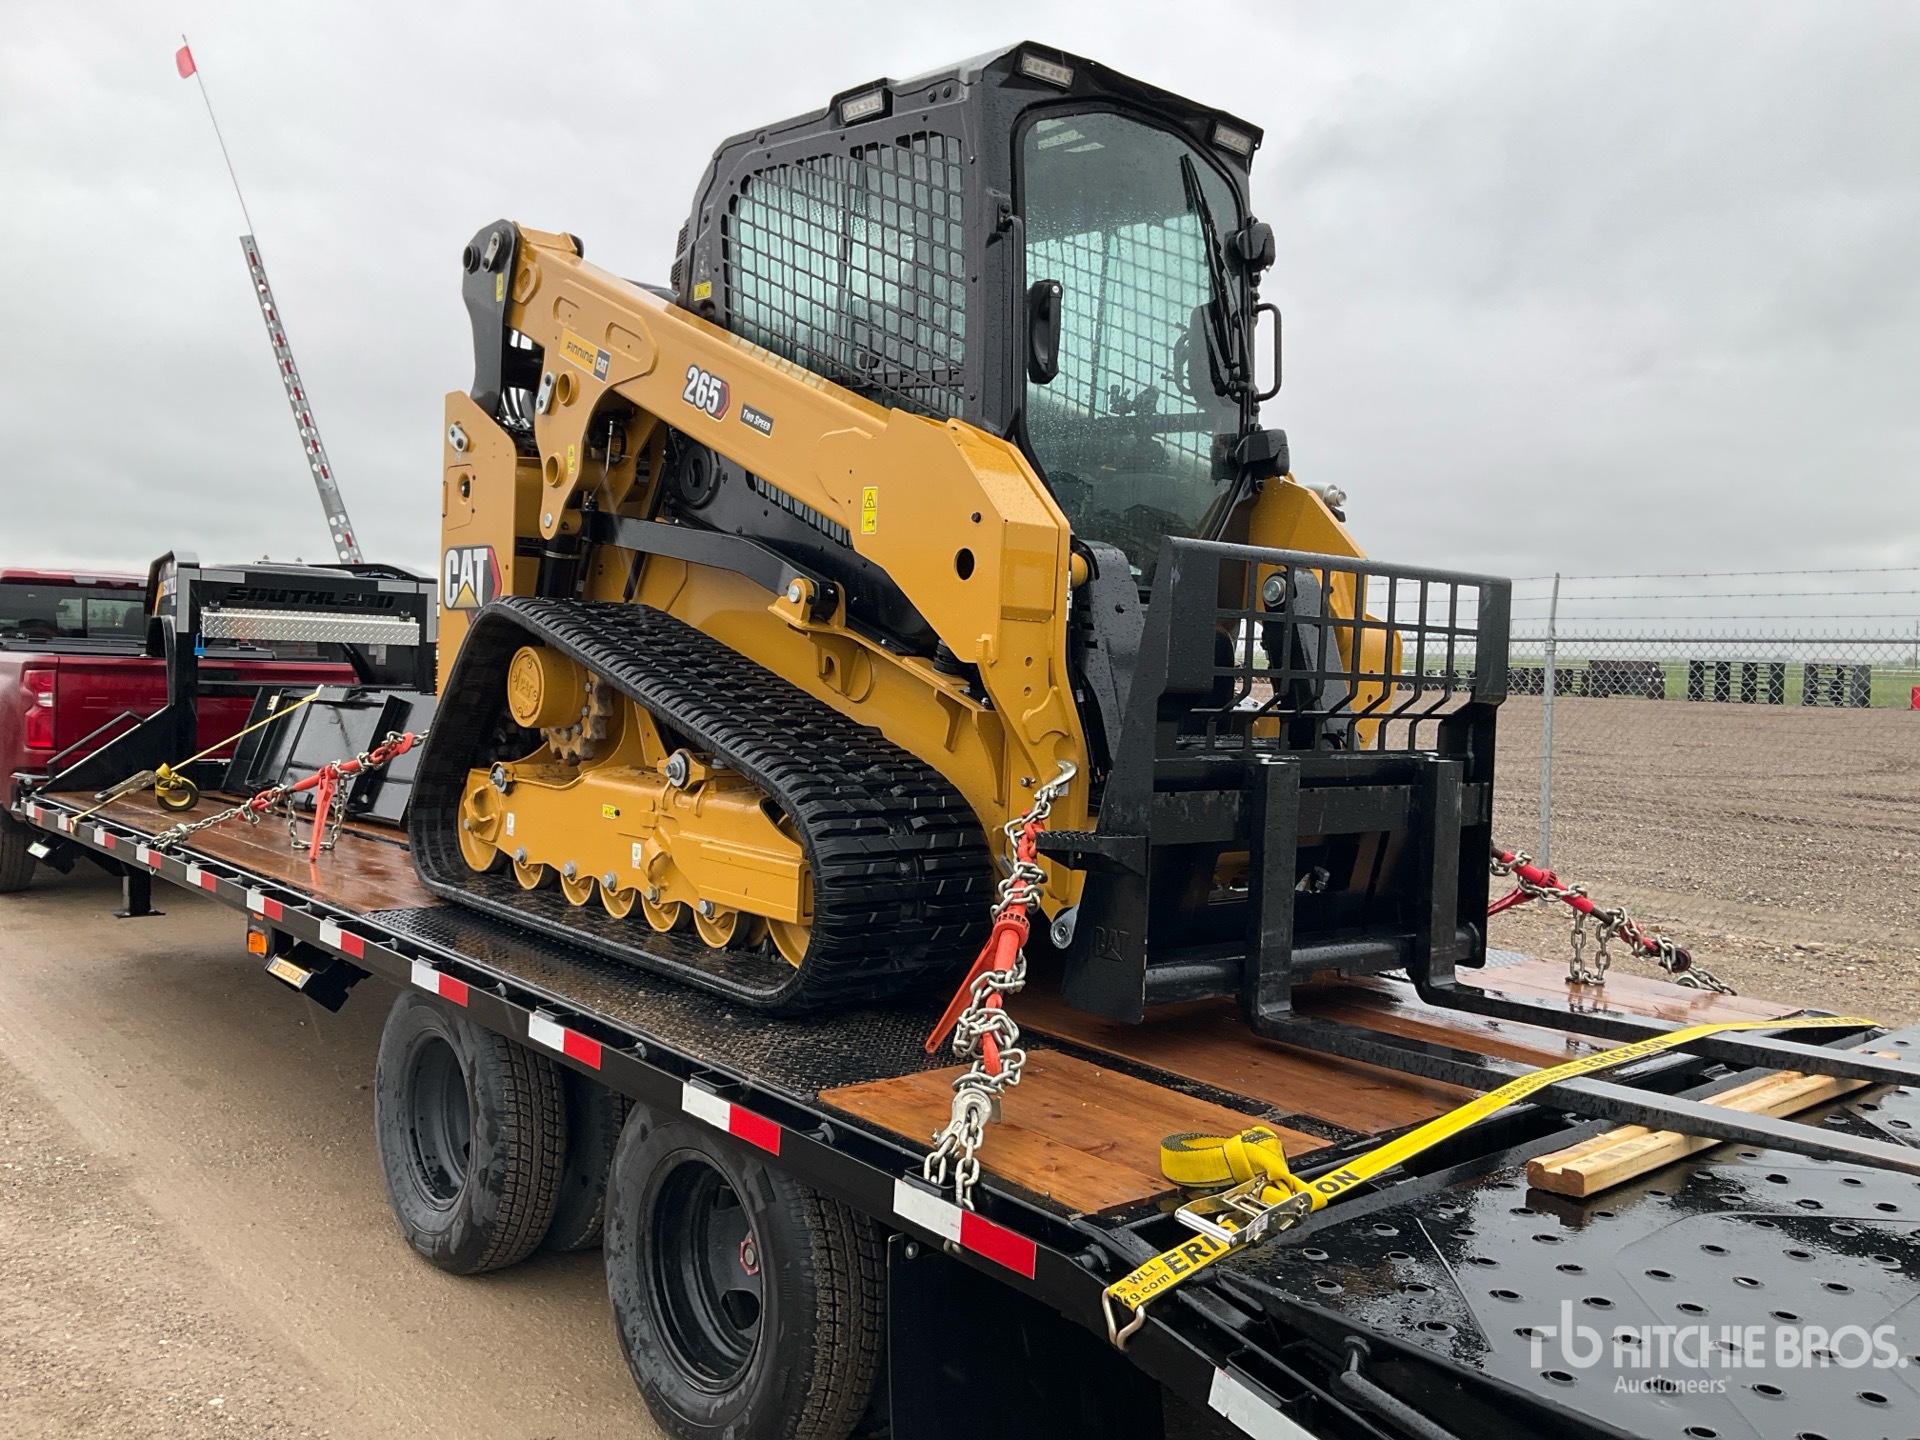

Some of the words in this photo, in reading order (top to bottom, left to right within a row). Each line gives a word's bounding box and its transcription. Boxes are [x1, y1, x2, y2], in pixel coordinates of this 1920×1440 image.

[566, 341, 594, 364] FINNING
[595, 356, 608, 374] CAT
[683, 365, 722, 414] 265
[444, 547, 488, 609] CAT
[1580, 1039, 1674, 1068] ERICKSON
[1315, 1169, 1362, 1194] ON
[1161, 1235, 1221, 1275] ERI
[1126, 1264, 1161, 1285] WLL
[1123, 1274, 1171, 1306] fg.com
